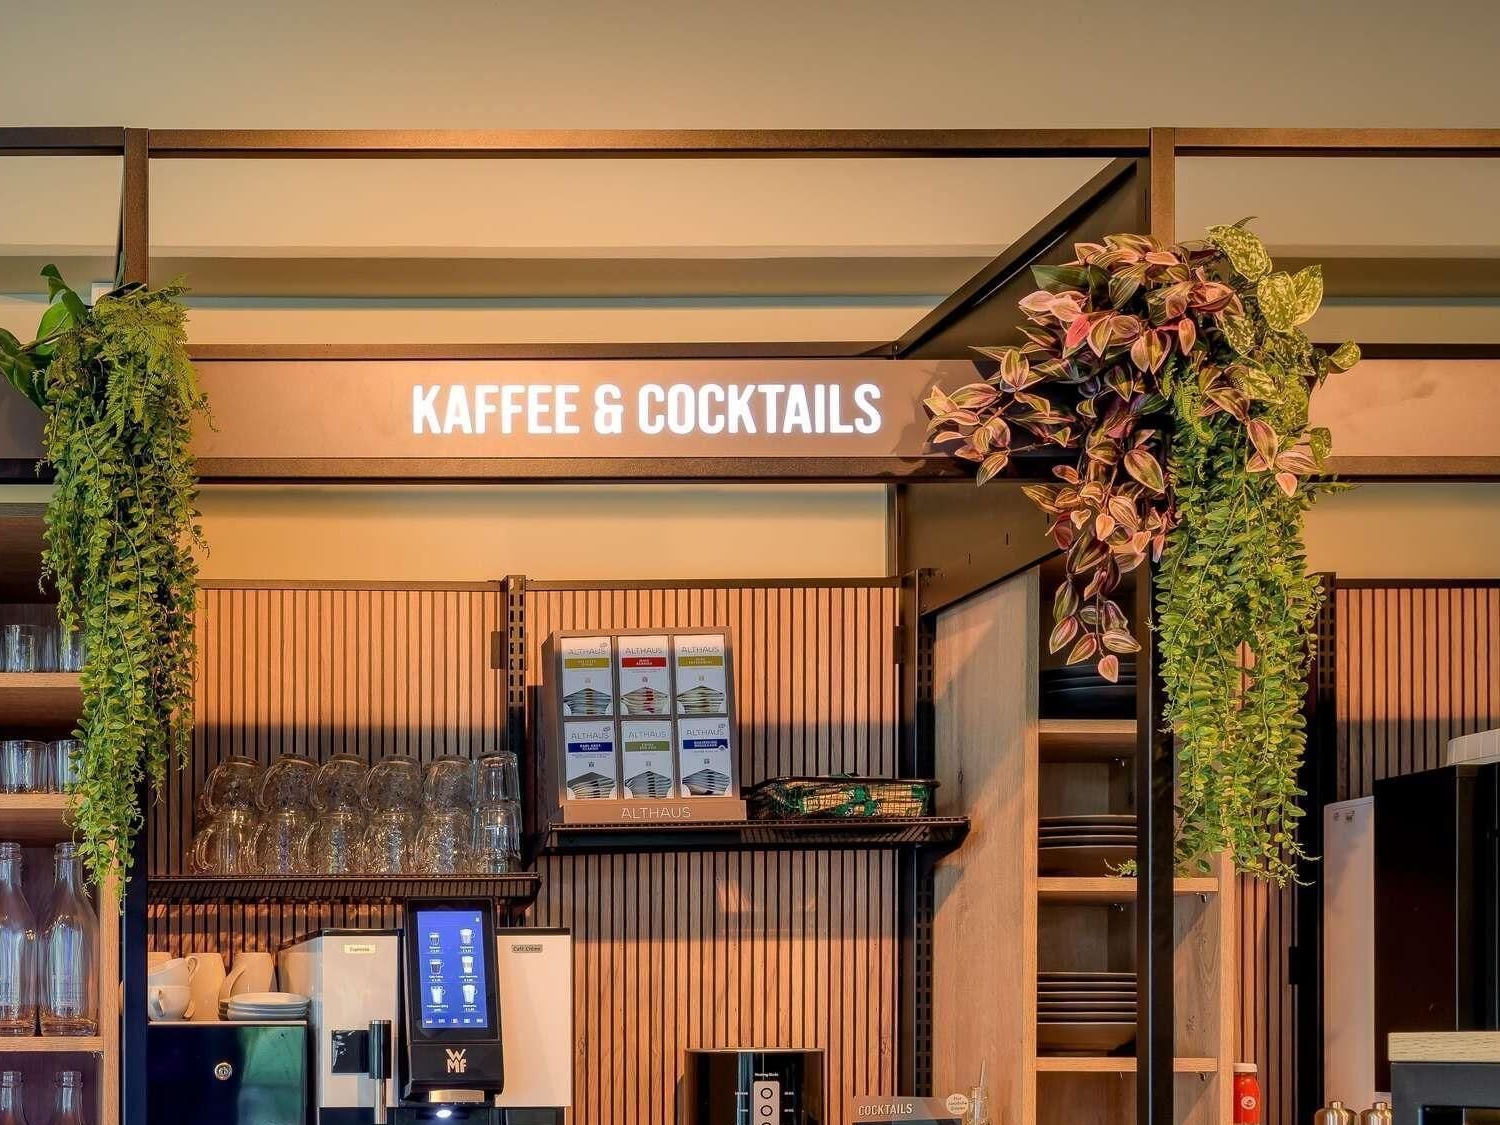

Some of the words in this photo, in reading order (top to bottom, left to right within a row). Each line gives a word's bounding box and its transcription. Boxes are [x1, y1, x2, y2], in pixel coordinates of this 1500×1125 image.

[412, 384, 580, 434] KAFFEE
[594, 384, 623, 434] &
[638, 384, 882, 434] COCKTAILS
[625, 647, 662, 655] ALTHAUS
[681, 646, 720, 654] ALTHAUS
[571, 732, 610, 740] ALTHAUS
[628, 730, 667, 738] ALTHAUS
[621, 806, 692, 819] ALTHAUS
[445, 1048, 468, 1074] WMF
[859, 1103, 913, 1116] COCKTAILS
